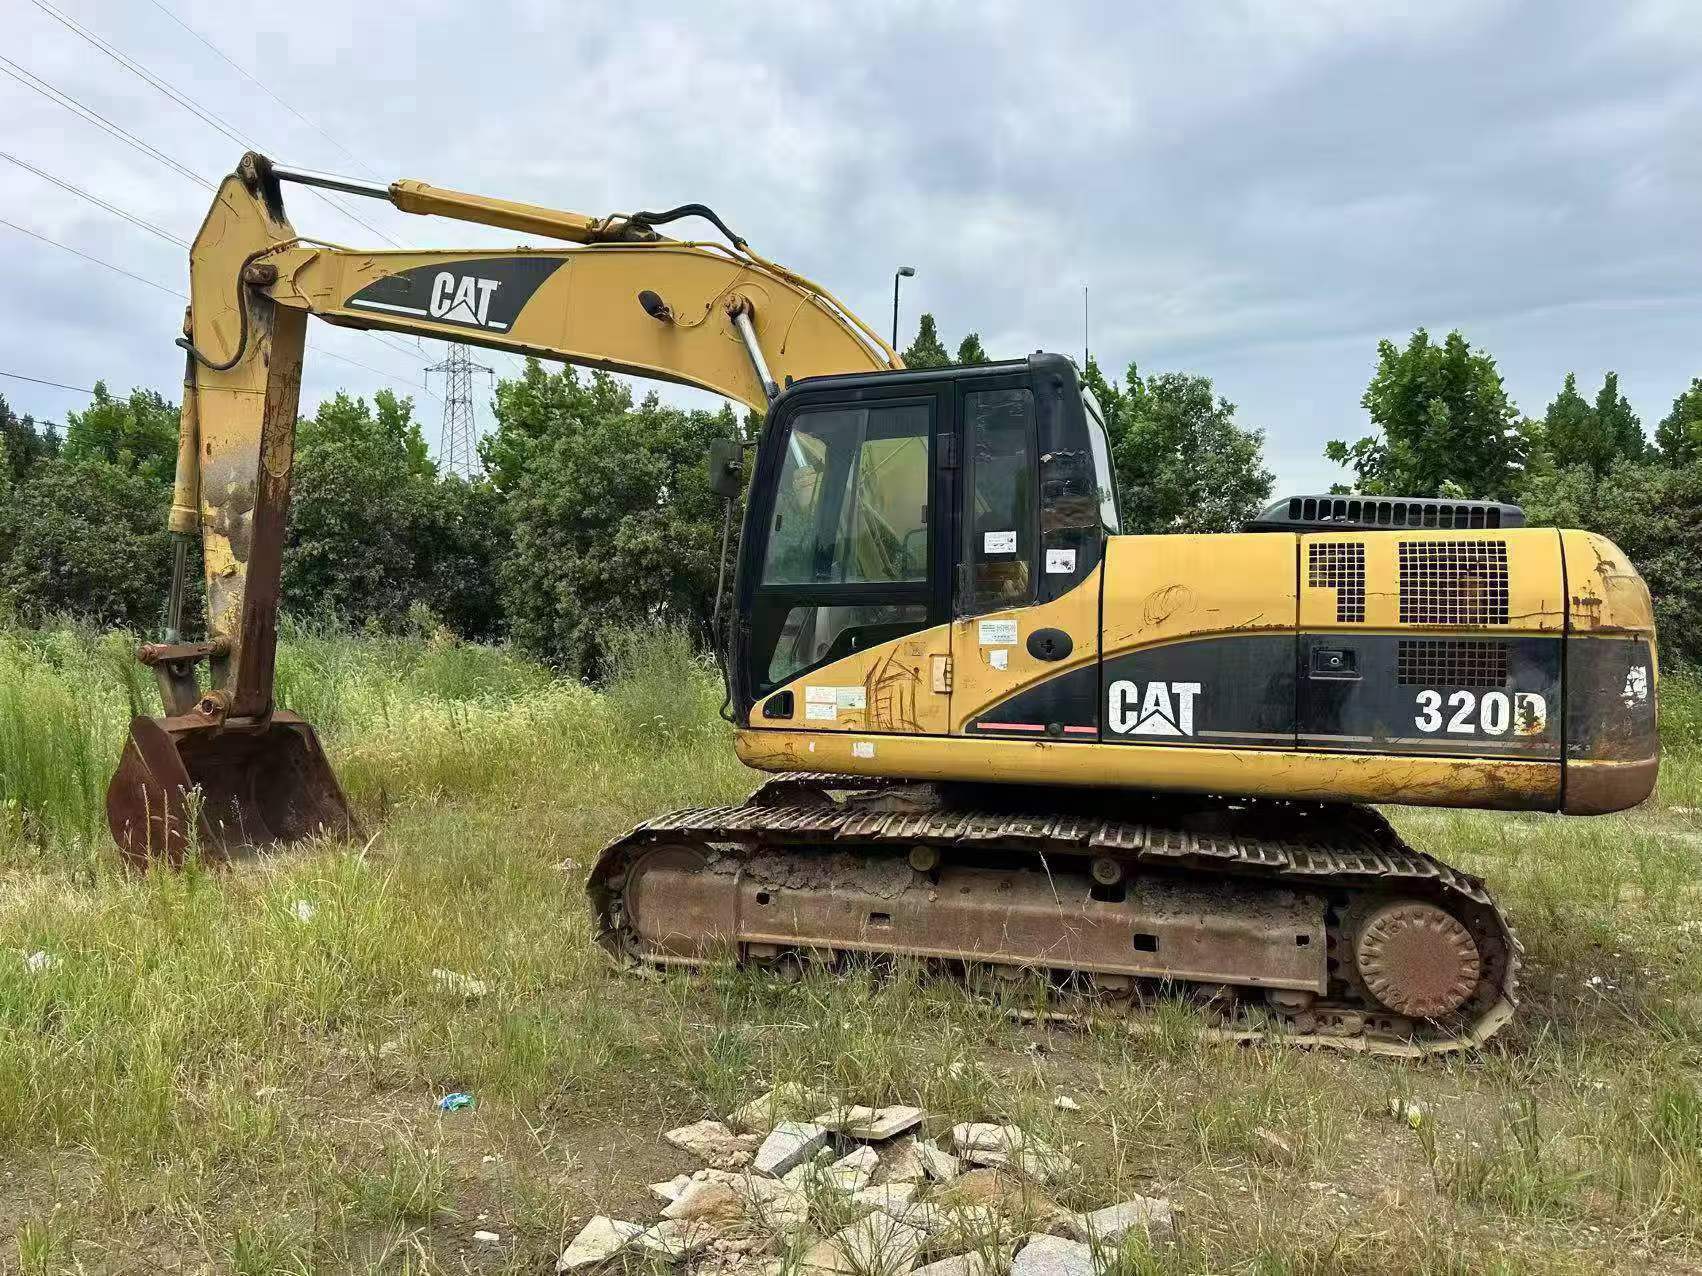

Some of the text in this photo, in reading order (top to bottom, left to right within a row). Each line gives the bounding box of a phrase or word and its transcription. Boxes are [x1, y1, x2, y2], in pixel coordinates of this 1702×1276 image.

[430, 271, 498, 326] CAT
[1108, 679, 1201, 736] CAT
[1414, 689, 1547, 736] 320D
